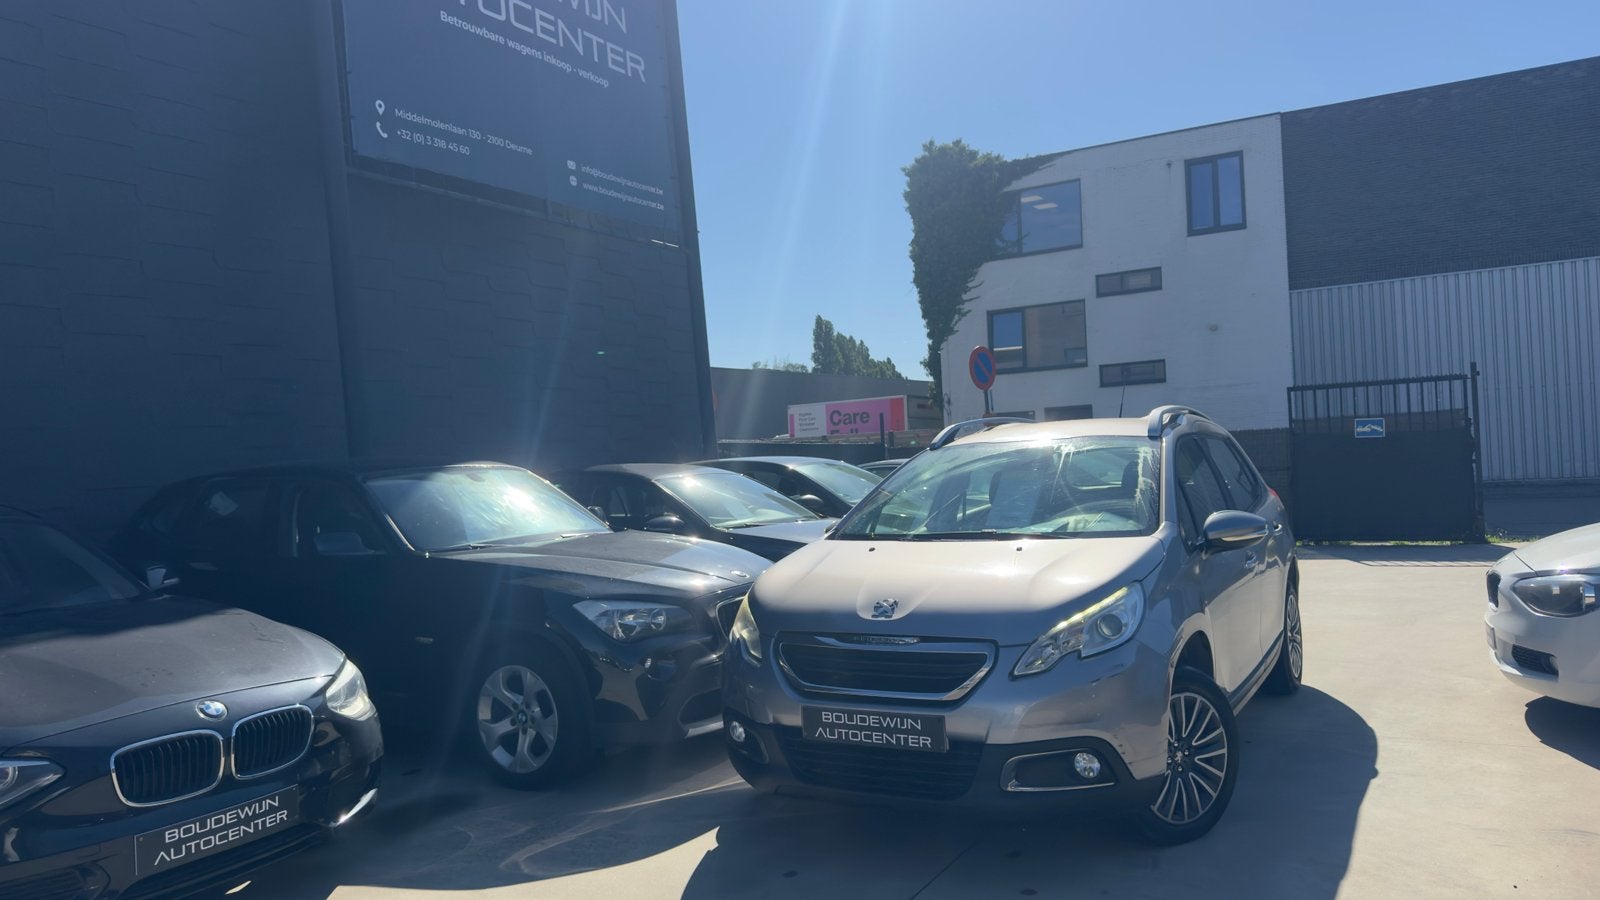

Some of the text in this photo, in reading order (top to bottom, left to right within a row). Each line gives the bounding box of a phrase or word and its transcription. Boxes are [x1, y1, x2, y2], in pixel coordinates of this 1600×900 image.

[440, 11, 505, 45] Betrouwbare
[506, 40, 542, 60] wagens
[543, 53, 572, 74] inkoop
[577, 67, 609, 88] verkoop
[395, 108, 468, 137] Middelmolenlaan
[469, 128, 481, 141] 130
[487, 135, 505, 147] 2100
[505, 139, 534, 156] Deurne
[397, 129, 470, 156] +32 (0) 3 318 45 60
[830, 410, 870, 426] Care
[815, 727, 932, 749] AUTOCENTER
[822, 711, 922, 731] BOUDEWIJN
[164, 795, 279, 843] BOUDEWIJN
[154, 810, 288, 866] AUTOCENTER
